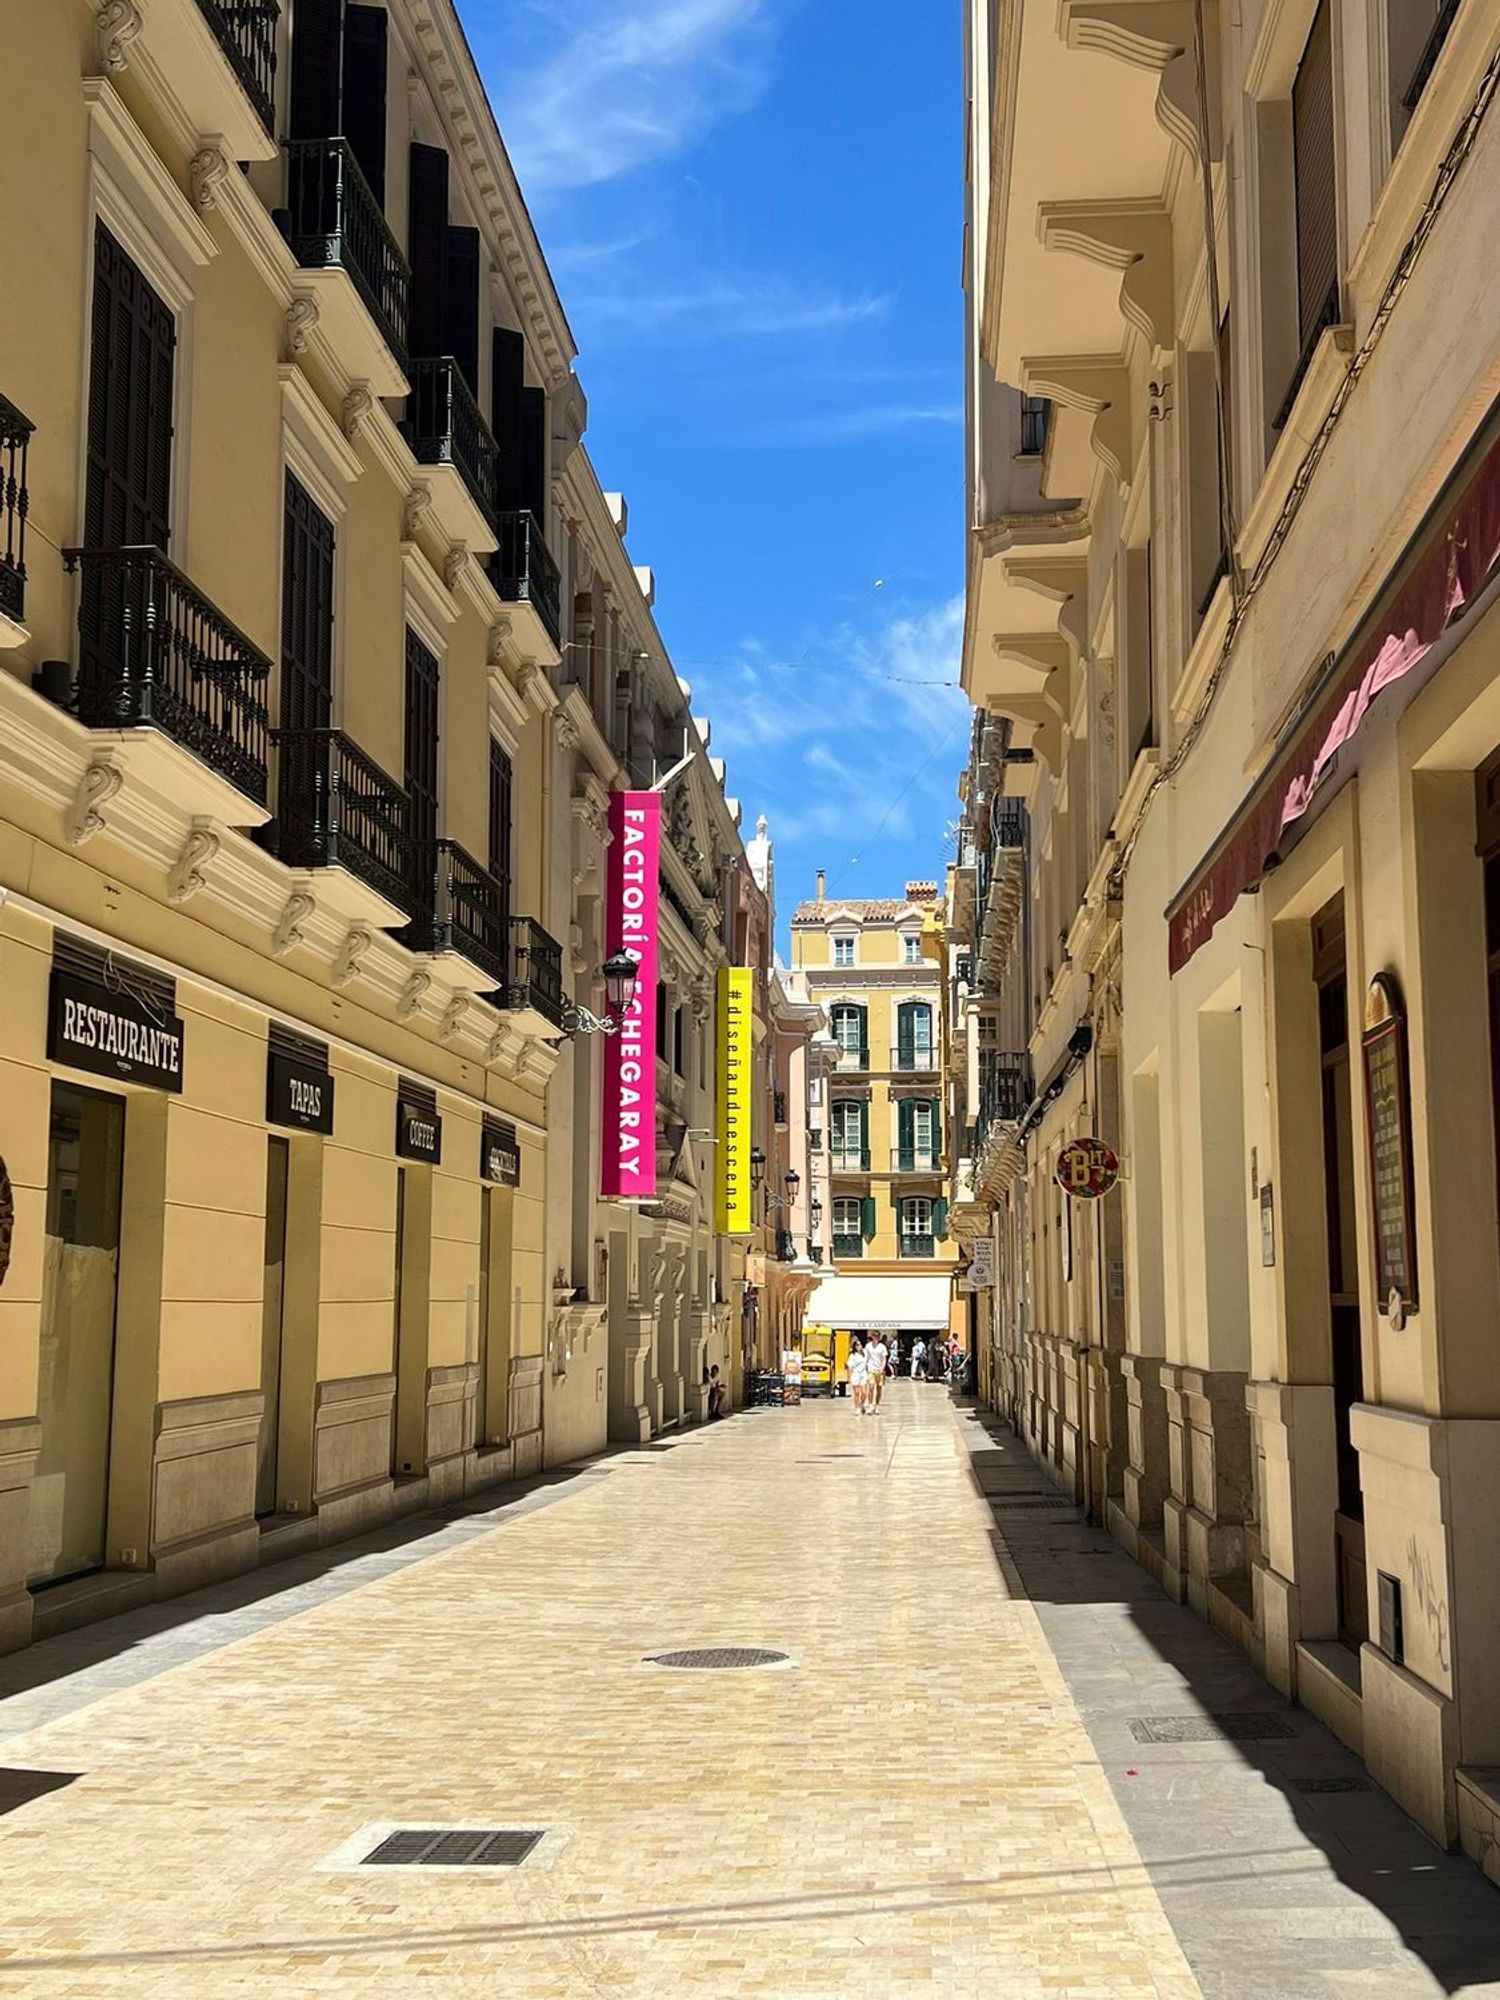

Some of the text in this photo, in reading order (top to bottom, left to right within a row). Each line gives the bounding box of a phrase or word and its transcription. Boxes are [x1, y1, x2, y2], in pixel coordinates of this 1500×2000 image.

[63, 998, 179, 1073] RESTAURANTE
[289, 1078, 321, 1117] TAPAS
[726, 989, 742, 1210] #diseñandoescena
[409, 1119, 435, 1151] COFFEE
